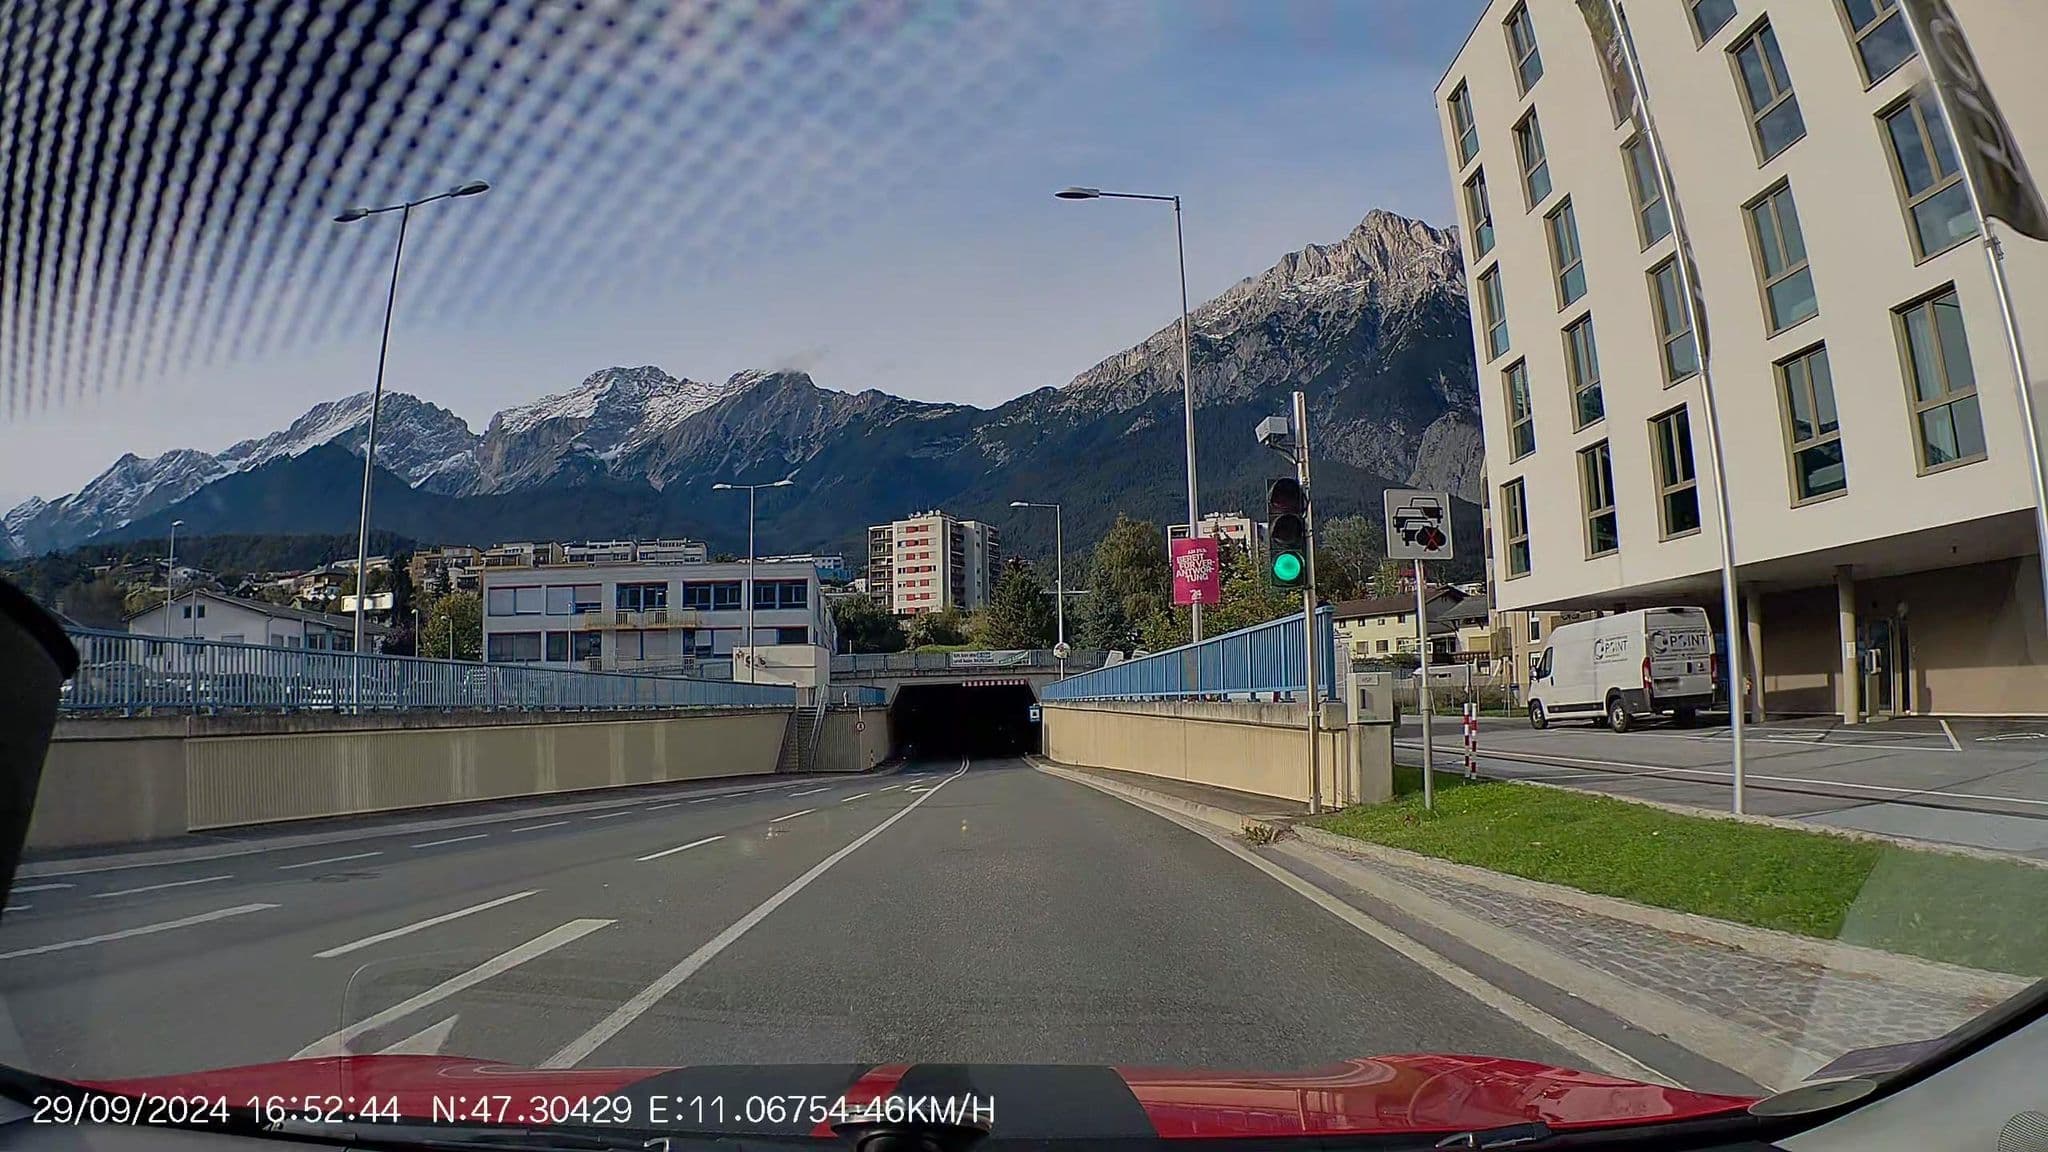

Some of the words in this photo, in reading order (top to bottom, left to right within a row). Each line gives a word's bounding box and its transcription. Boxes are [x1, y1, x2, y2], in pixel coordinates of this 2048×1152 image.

[1176, 554, 1204, 564] BEREIT
[1196, 559, 1216, 569] VER-
[1185, 573, 1209, 582] TUNG
[1670, 634, 1706, 648] POINT
